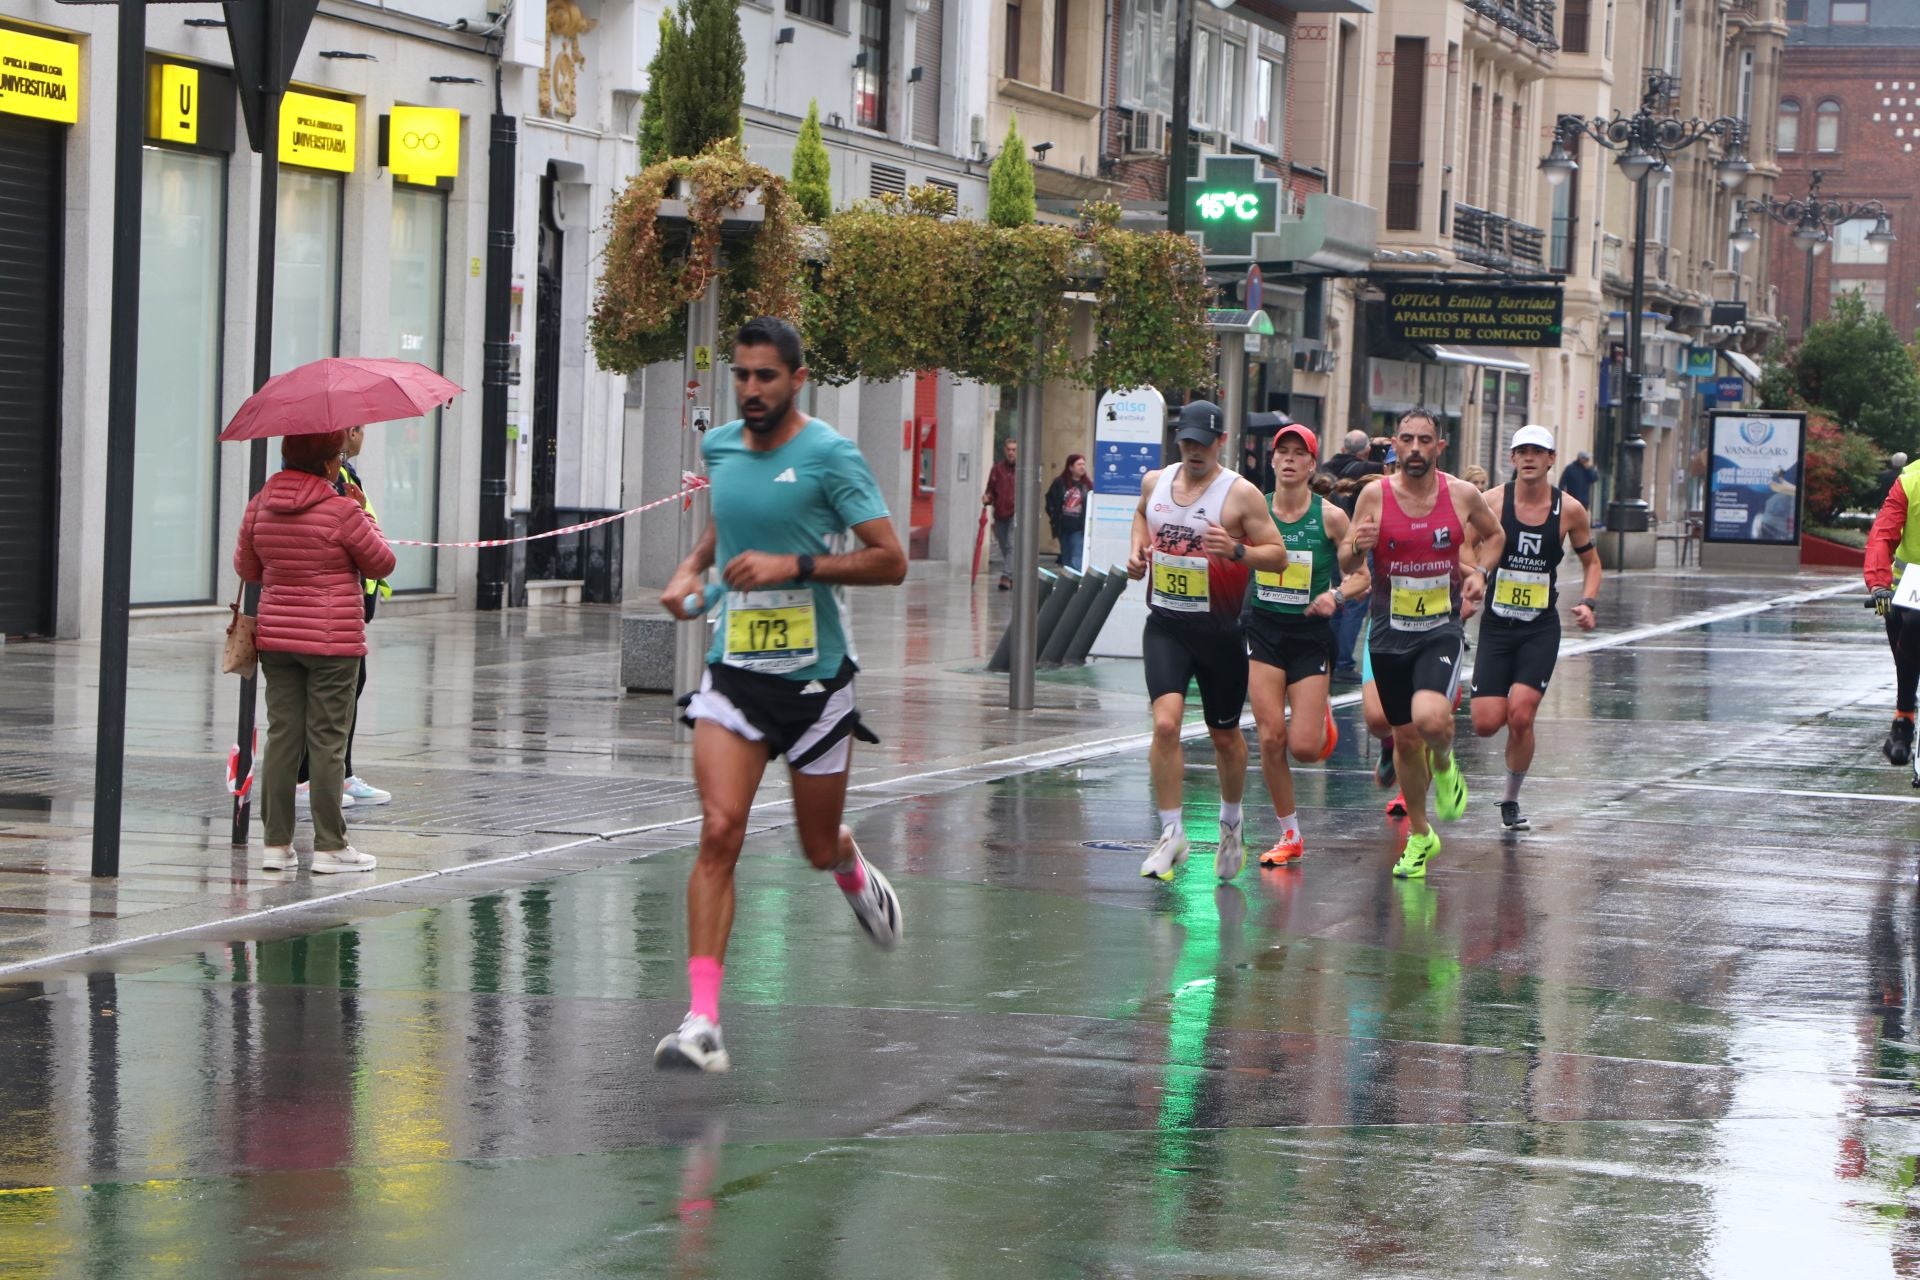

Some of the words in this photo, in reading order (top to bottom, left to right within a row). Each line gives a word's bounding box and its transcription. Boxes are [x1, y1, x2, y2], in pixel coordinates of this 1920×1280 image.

[180, 84, 191, 115] U
[1448, 295, 1492, 309] Emilia
[1497, 296, 1557, 310] Barriada
[1394, 312, 1459, 323] APARATOS
[1463, 313, 1496, 324] PARA
[1501, 314, 1553, 326] SORDOS
[1404, 327, 1450, 339] LENTES
[1455, 328, 1472, 339] DE
[1476, 329, 1541, 341] CONTACTO
[1115, 401, 1147, 413] alsa
[1508, 554, 1547, 567] FARTAKH
[1510, 563, 1543, 572] NUTRITION
[1166, 573, 1188, 595] 39
[1511, 587, 1532, 607] 85
[1415, 596, 1426, 616] 4
[749, 618, 788, 651] 173
